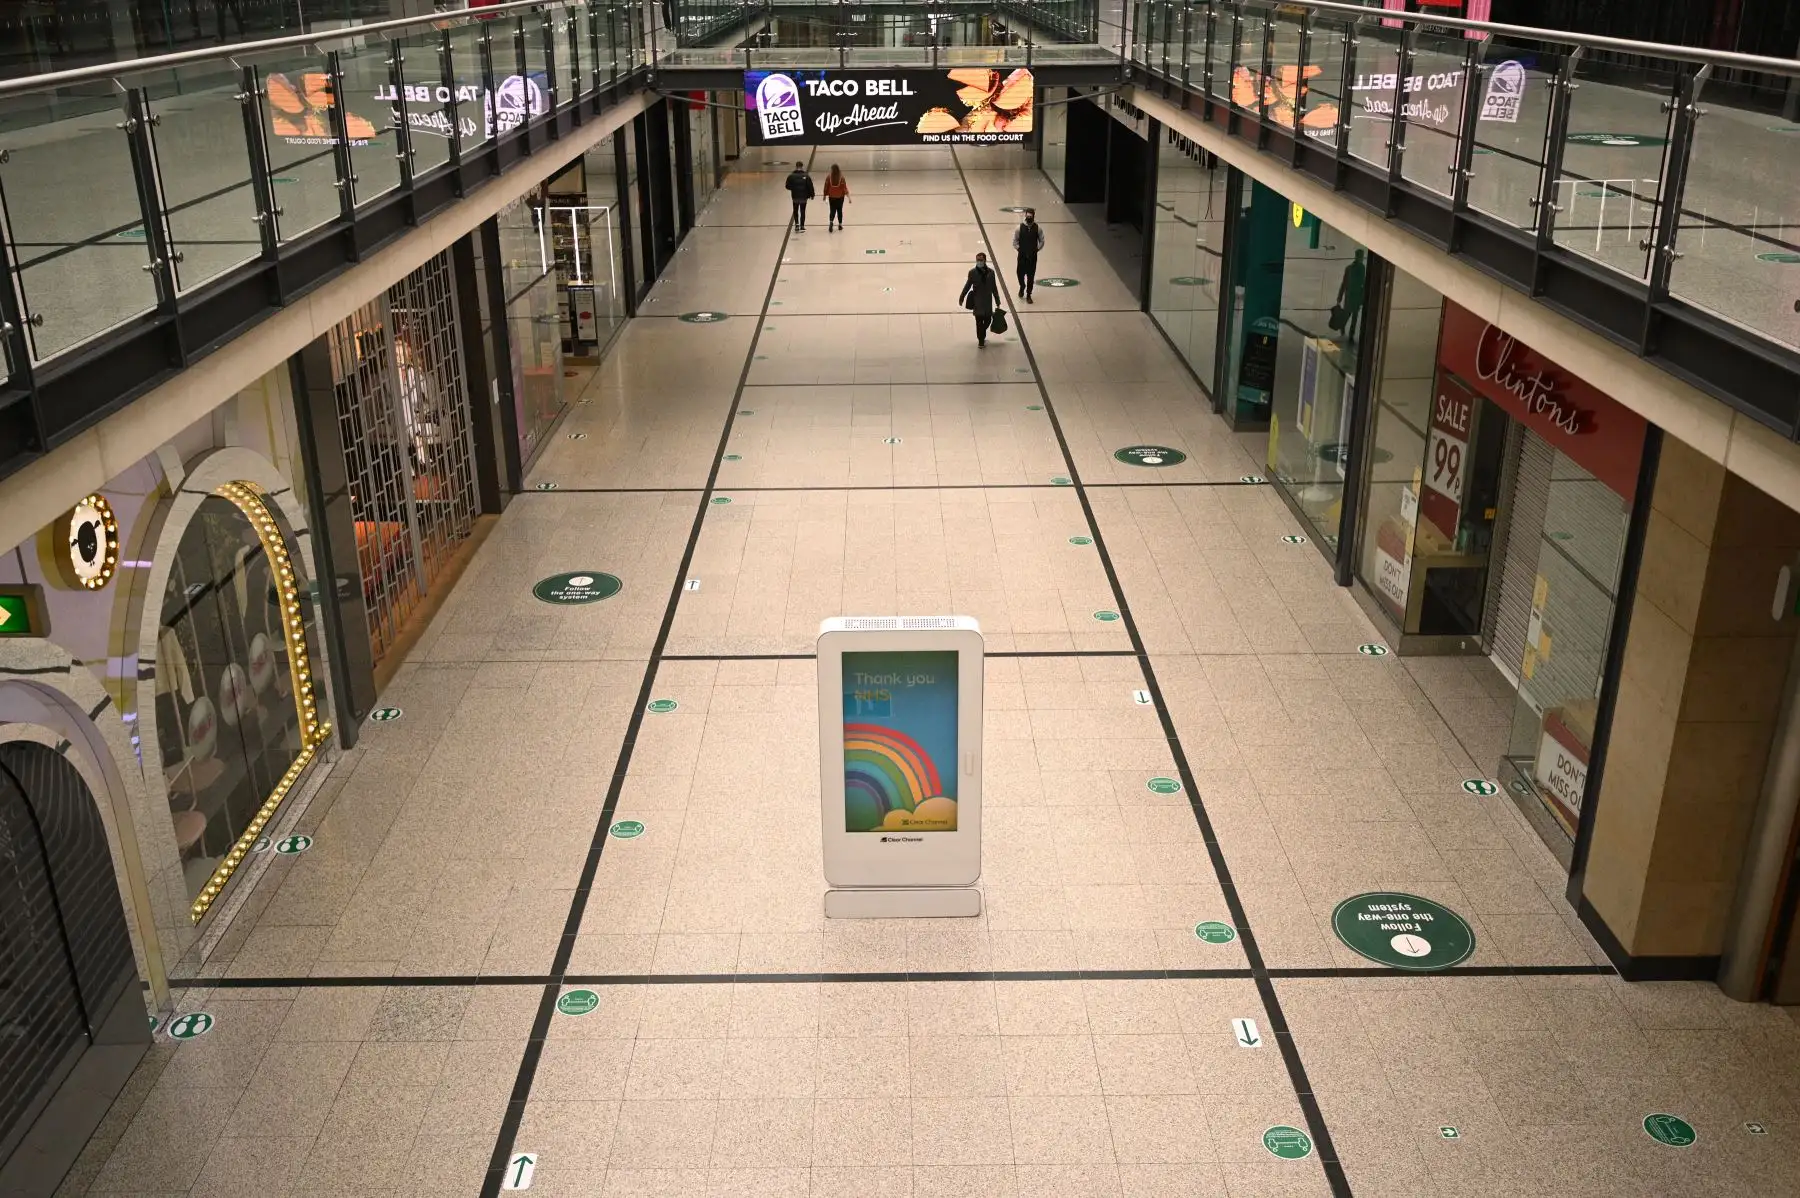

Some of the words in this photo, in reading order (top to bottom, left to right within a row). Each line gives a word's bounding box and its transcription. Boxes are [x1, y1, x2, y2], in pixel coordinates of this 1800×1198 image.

[805, 80, 858, 96] TACO
[866, 80, 914, 95] BELL
[764, 110, 799, 123] TACO
[815, 112, 842, 132] Up
[844, 102, 898, 125] Ahead
[768, 123, 800, 135] BELL
[1476, 322, 1578, 435] Clintons
[1437, 395, 1468, 432] SALE
[853, 673, 902, 684] Thank
[907, 674, 934, 687] you
[1548, 770, 1570, 798] MISS
[1368, 904, 1411, 912] system
[1358, 912, 1410, 921] one-way
[1412, 913, 1434, 921] the
[1380, 922, 1421, 932] Follow
